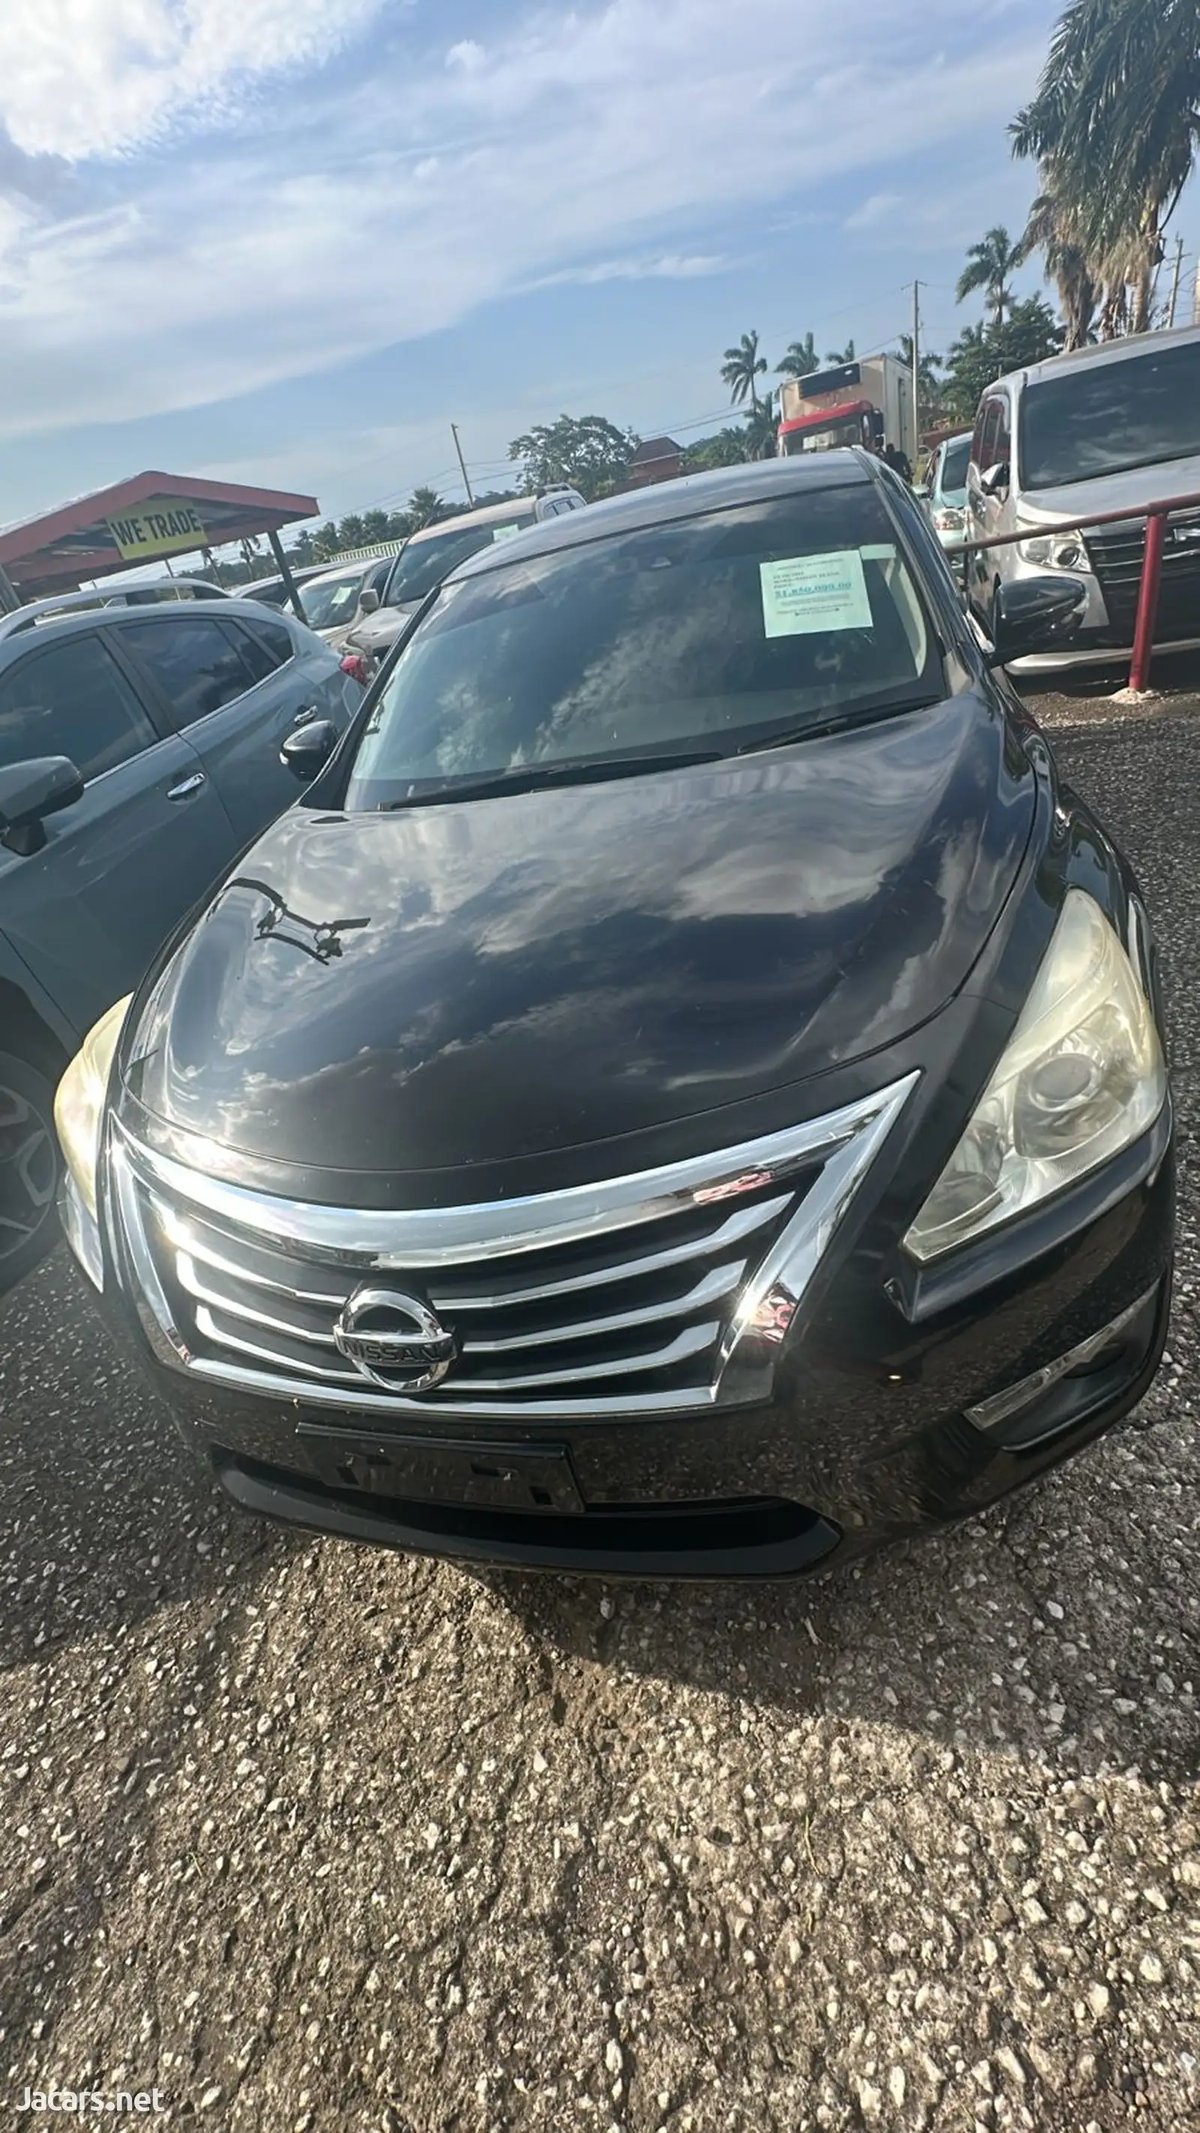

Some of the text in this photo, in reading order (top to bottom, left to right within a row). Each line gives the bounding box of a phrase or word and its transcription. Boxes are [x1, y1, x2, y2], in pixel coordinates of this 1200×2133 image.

[110, 508, 202, 546] WE TRADE
[342, 1338, 452, 1363] NISSAN
